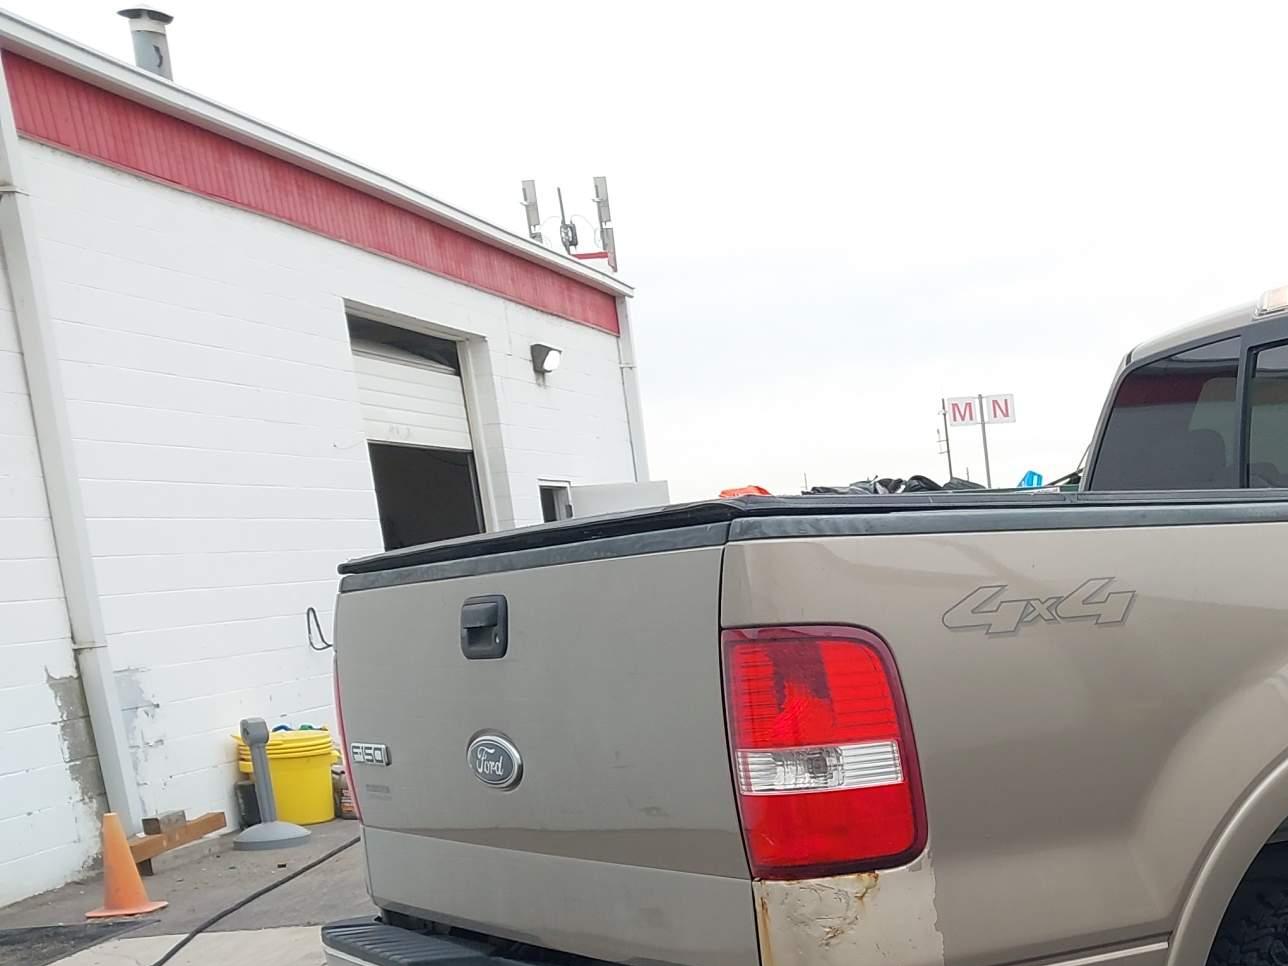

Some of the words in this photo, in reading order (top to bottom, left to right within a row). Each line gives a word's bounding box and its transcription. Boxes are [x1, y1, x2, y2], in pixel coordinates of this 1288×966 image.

[951, 402, 973, 422] M
[992, 398, 1009, 418] N
[477, 746, 503, 775] Ford
